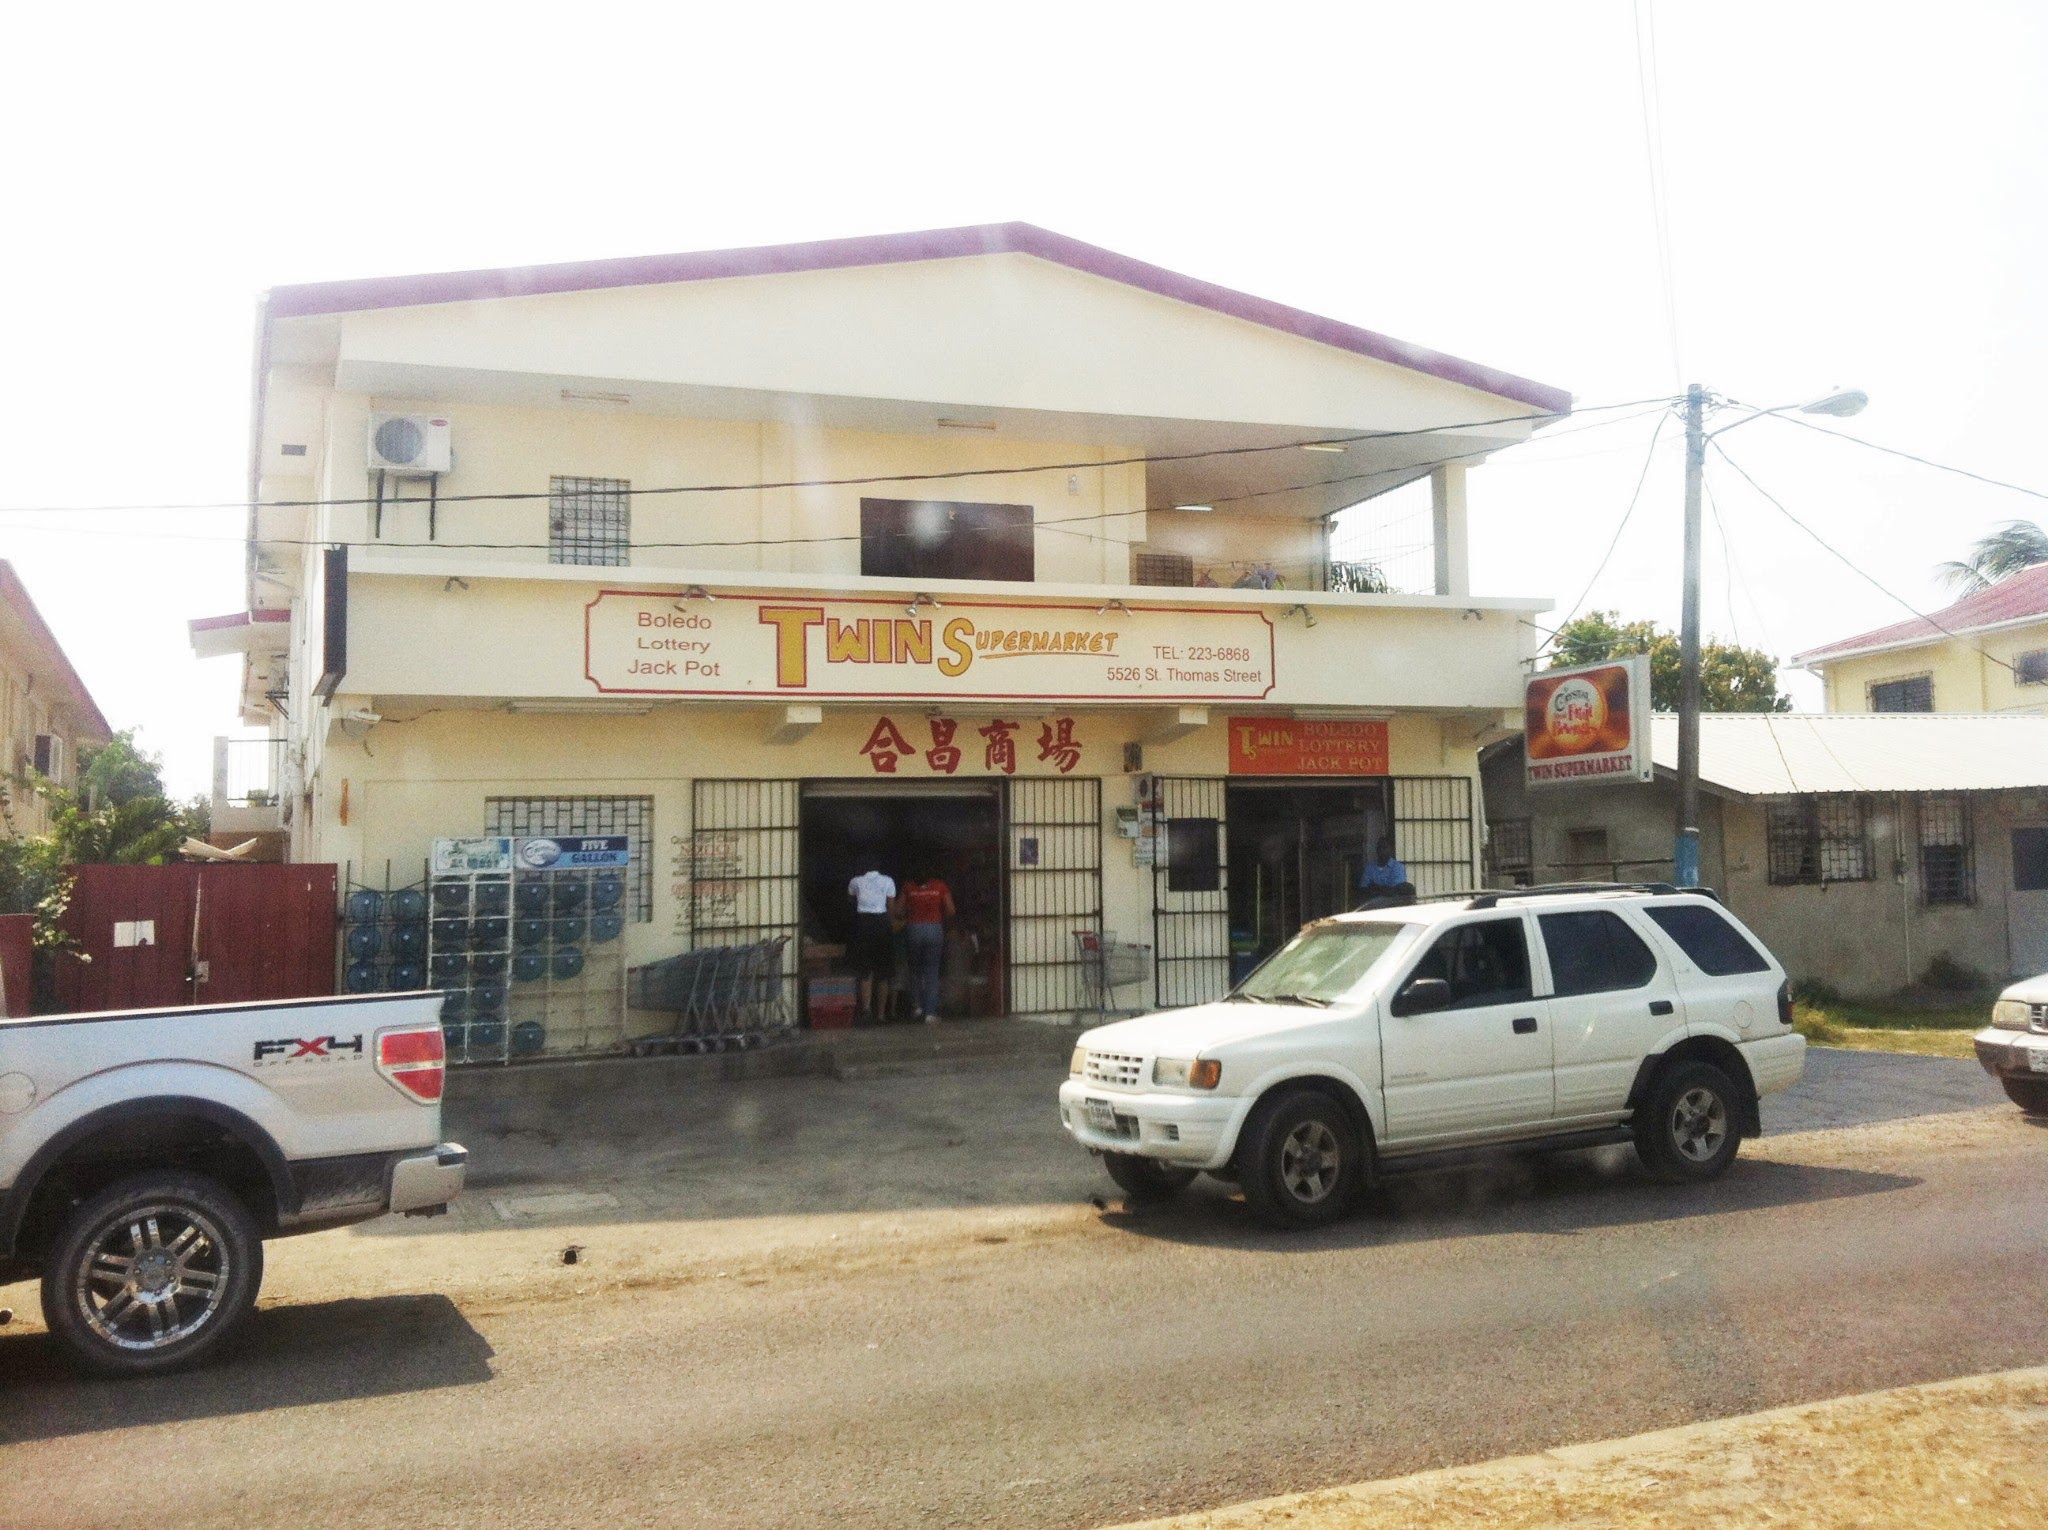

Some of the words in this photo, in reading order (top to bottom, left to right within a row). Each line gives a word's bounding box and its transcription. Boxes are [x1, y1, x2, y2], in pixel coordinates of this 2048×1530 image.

[637, 612, 712, 630] Boledo
[637, 637, 711, 654] Lottery
[1152, 645, 1185, 661] TEL:
[1188, 647, 1250, 662] 223-6868
[628, 659, 678, 676] Jack
[685, 660, 721, 677] Pot
[1107, 667, 1141, 682] 5526
[1144, 667, 1162, 682] St.
[1166, 668, 1220, 683] Thomas
[1223, 669, 1262, 683] Street
[1303, 722, 1378, 737] BOLEDO
[859, 716, 1083, 775] 合昌商場
[1237, 726, 1294, 756] TWIN
[1299, 738, 1381, 753] LOTTERY
[1297, 755, 1343, 770] JACK
[1348, 757, 1384, 770] POT
[1554, 755, 1632, 779] SUPERMARKET
[581, 840, 609, 850] FIVE
[571, 853, 617, 863] GALLON
[253, 1034, 363, 1060] FX4
[305, 1054, 363, 1064] ROAD
